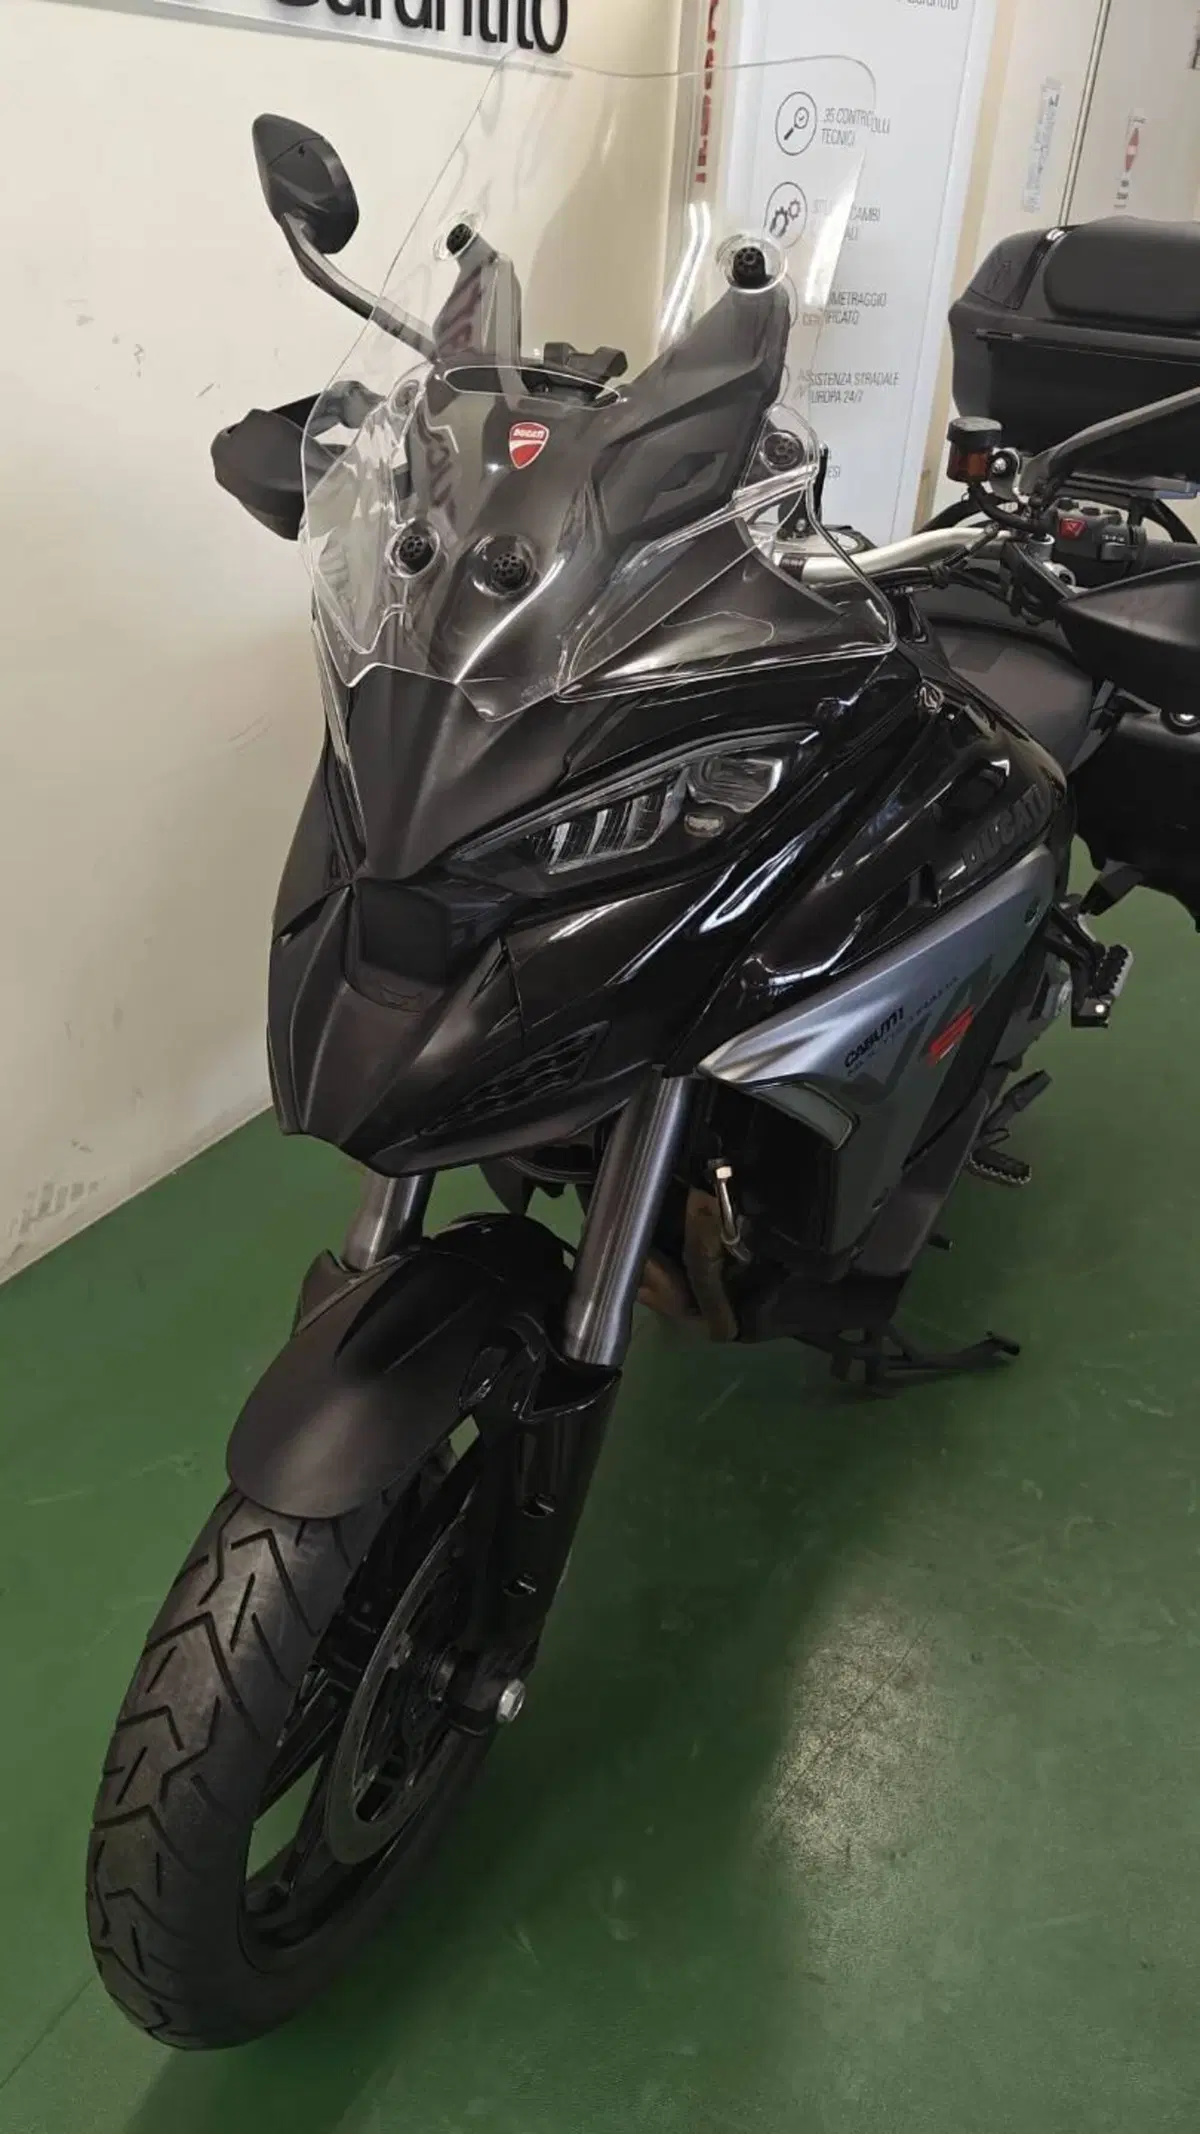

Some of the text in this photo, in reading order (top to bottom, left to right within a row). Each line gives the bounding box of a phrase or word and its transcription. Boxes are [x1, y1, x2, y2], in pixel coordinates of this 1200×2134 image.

[821, 127, 856, 148] TECNICI
[512, 427, 546, 440] DUCATI
[959, 783, 1048, 877] DUCATI
